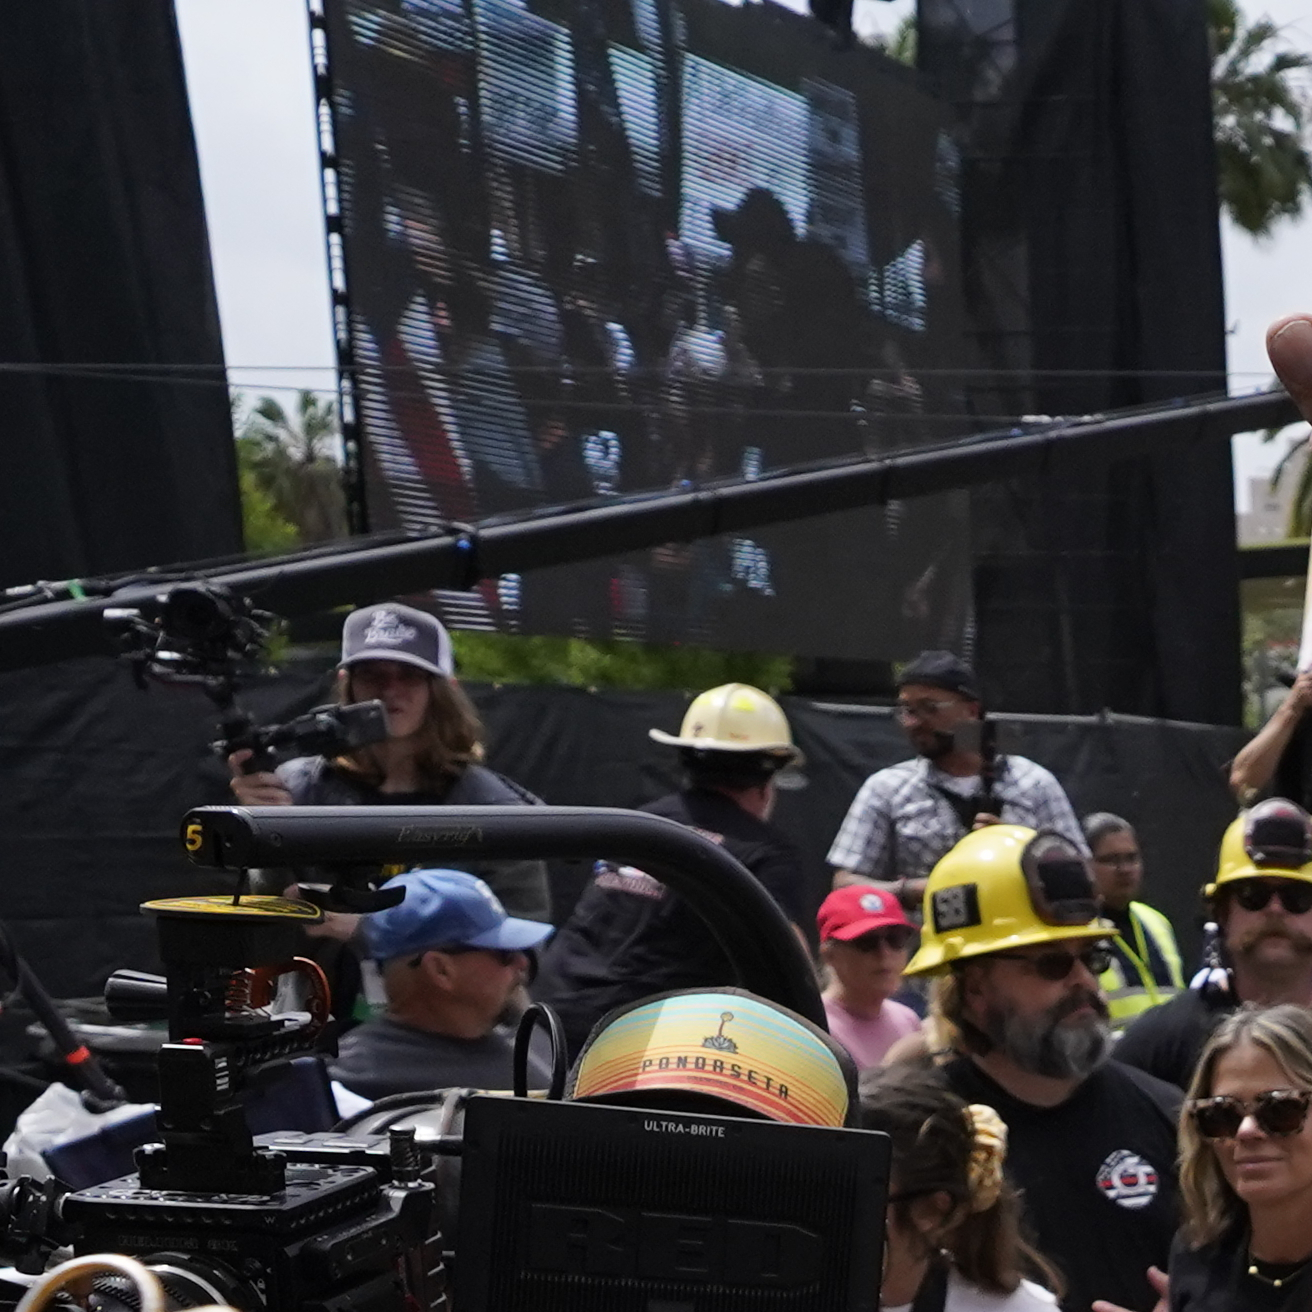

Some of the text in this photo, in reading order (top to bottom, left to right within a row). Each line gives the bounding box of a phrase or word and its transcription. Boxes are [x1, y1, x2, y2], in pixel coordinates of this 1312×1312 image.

[185, 824, 204, 851] 5
[642, 1056, 789, 1099] PONDASETA
[644, 1120, 726, 1137] ULTRA-BRITE
